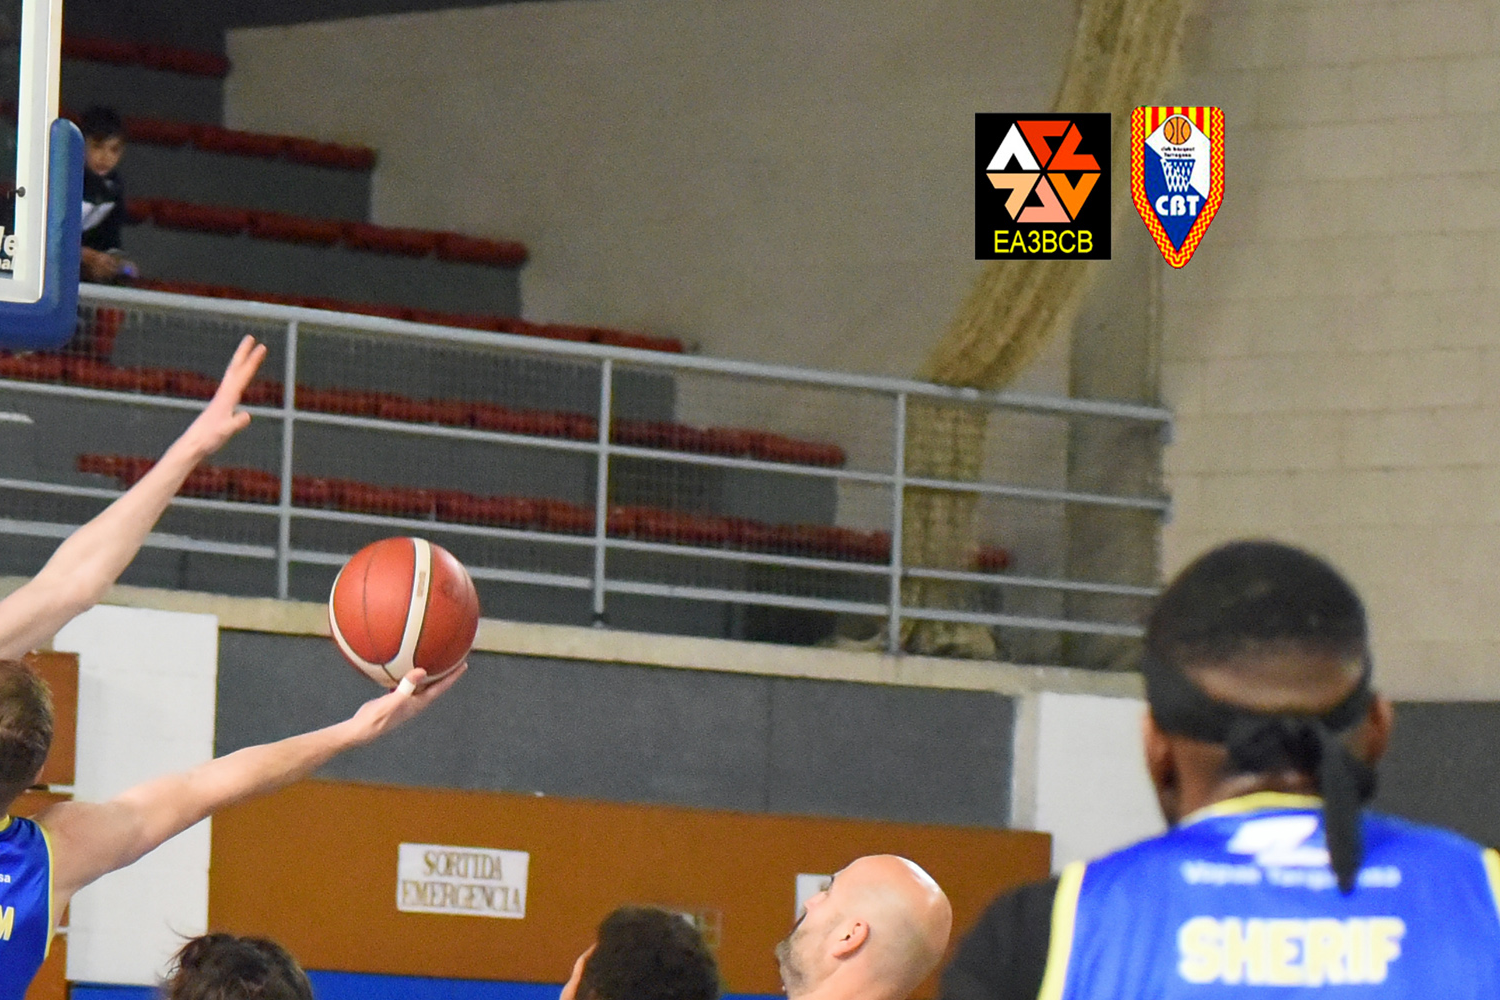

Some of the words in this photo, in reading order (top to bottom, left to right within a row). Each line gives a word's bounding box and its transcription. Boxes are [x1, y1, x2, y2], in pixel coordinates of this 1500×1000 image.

[423, 851, 503, 881] SORTIDA
[401, 880, 524, 914] EMERGENCIA
[1177, 915, 1407, 987] SHERIF
